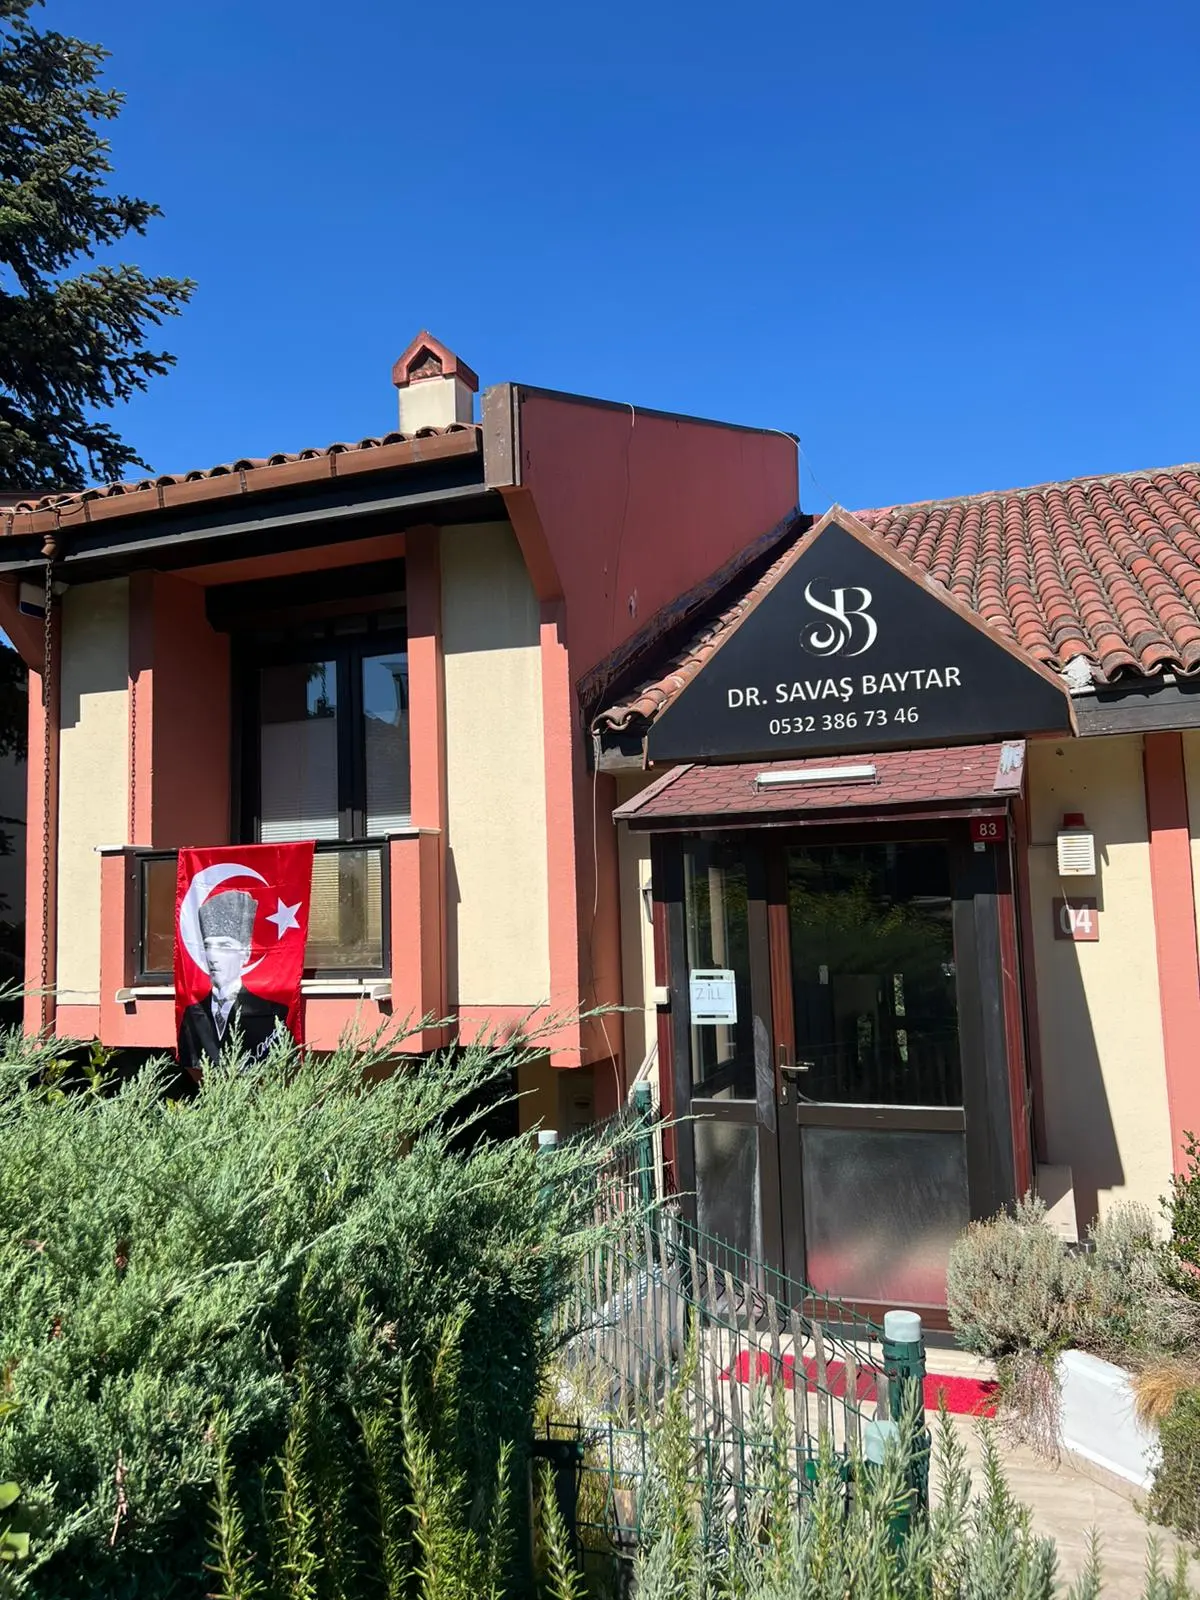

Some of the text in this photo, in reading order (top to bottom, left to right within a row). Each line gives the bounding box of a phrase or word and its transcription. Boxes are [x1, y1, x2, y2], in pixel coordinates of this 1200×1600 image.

[727, 667, 962, 708] DR. SAVAŞ BAYTAR
[769, 707, 919, 735] 0532 386 73 46
[979, 823, 997, 836] 83
[1060, 904, 1092, 934] 04
